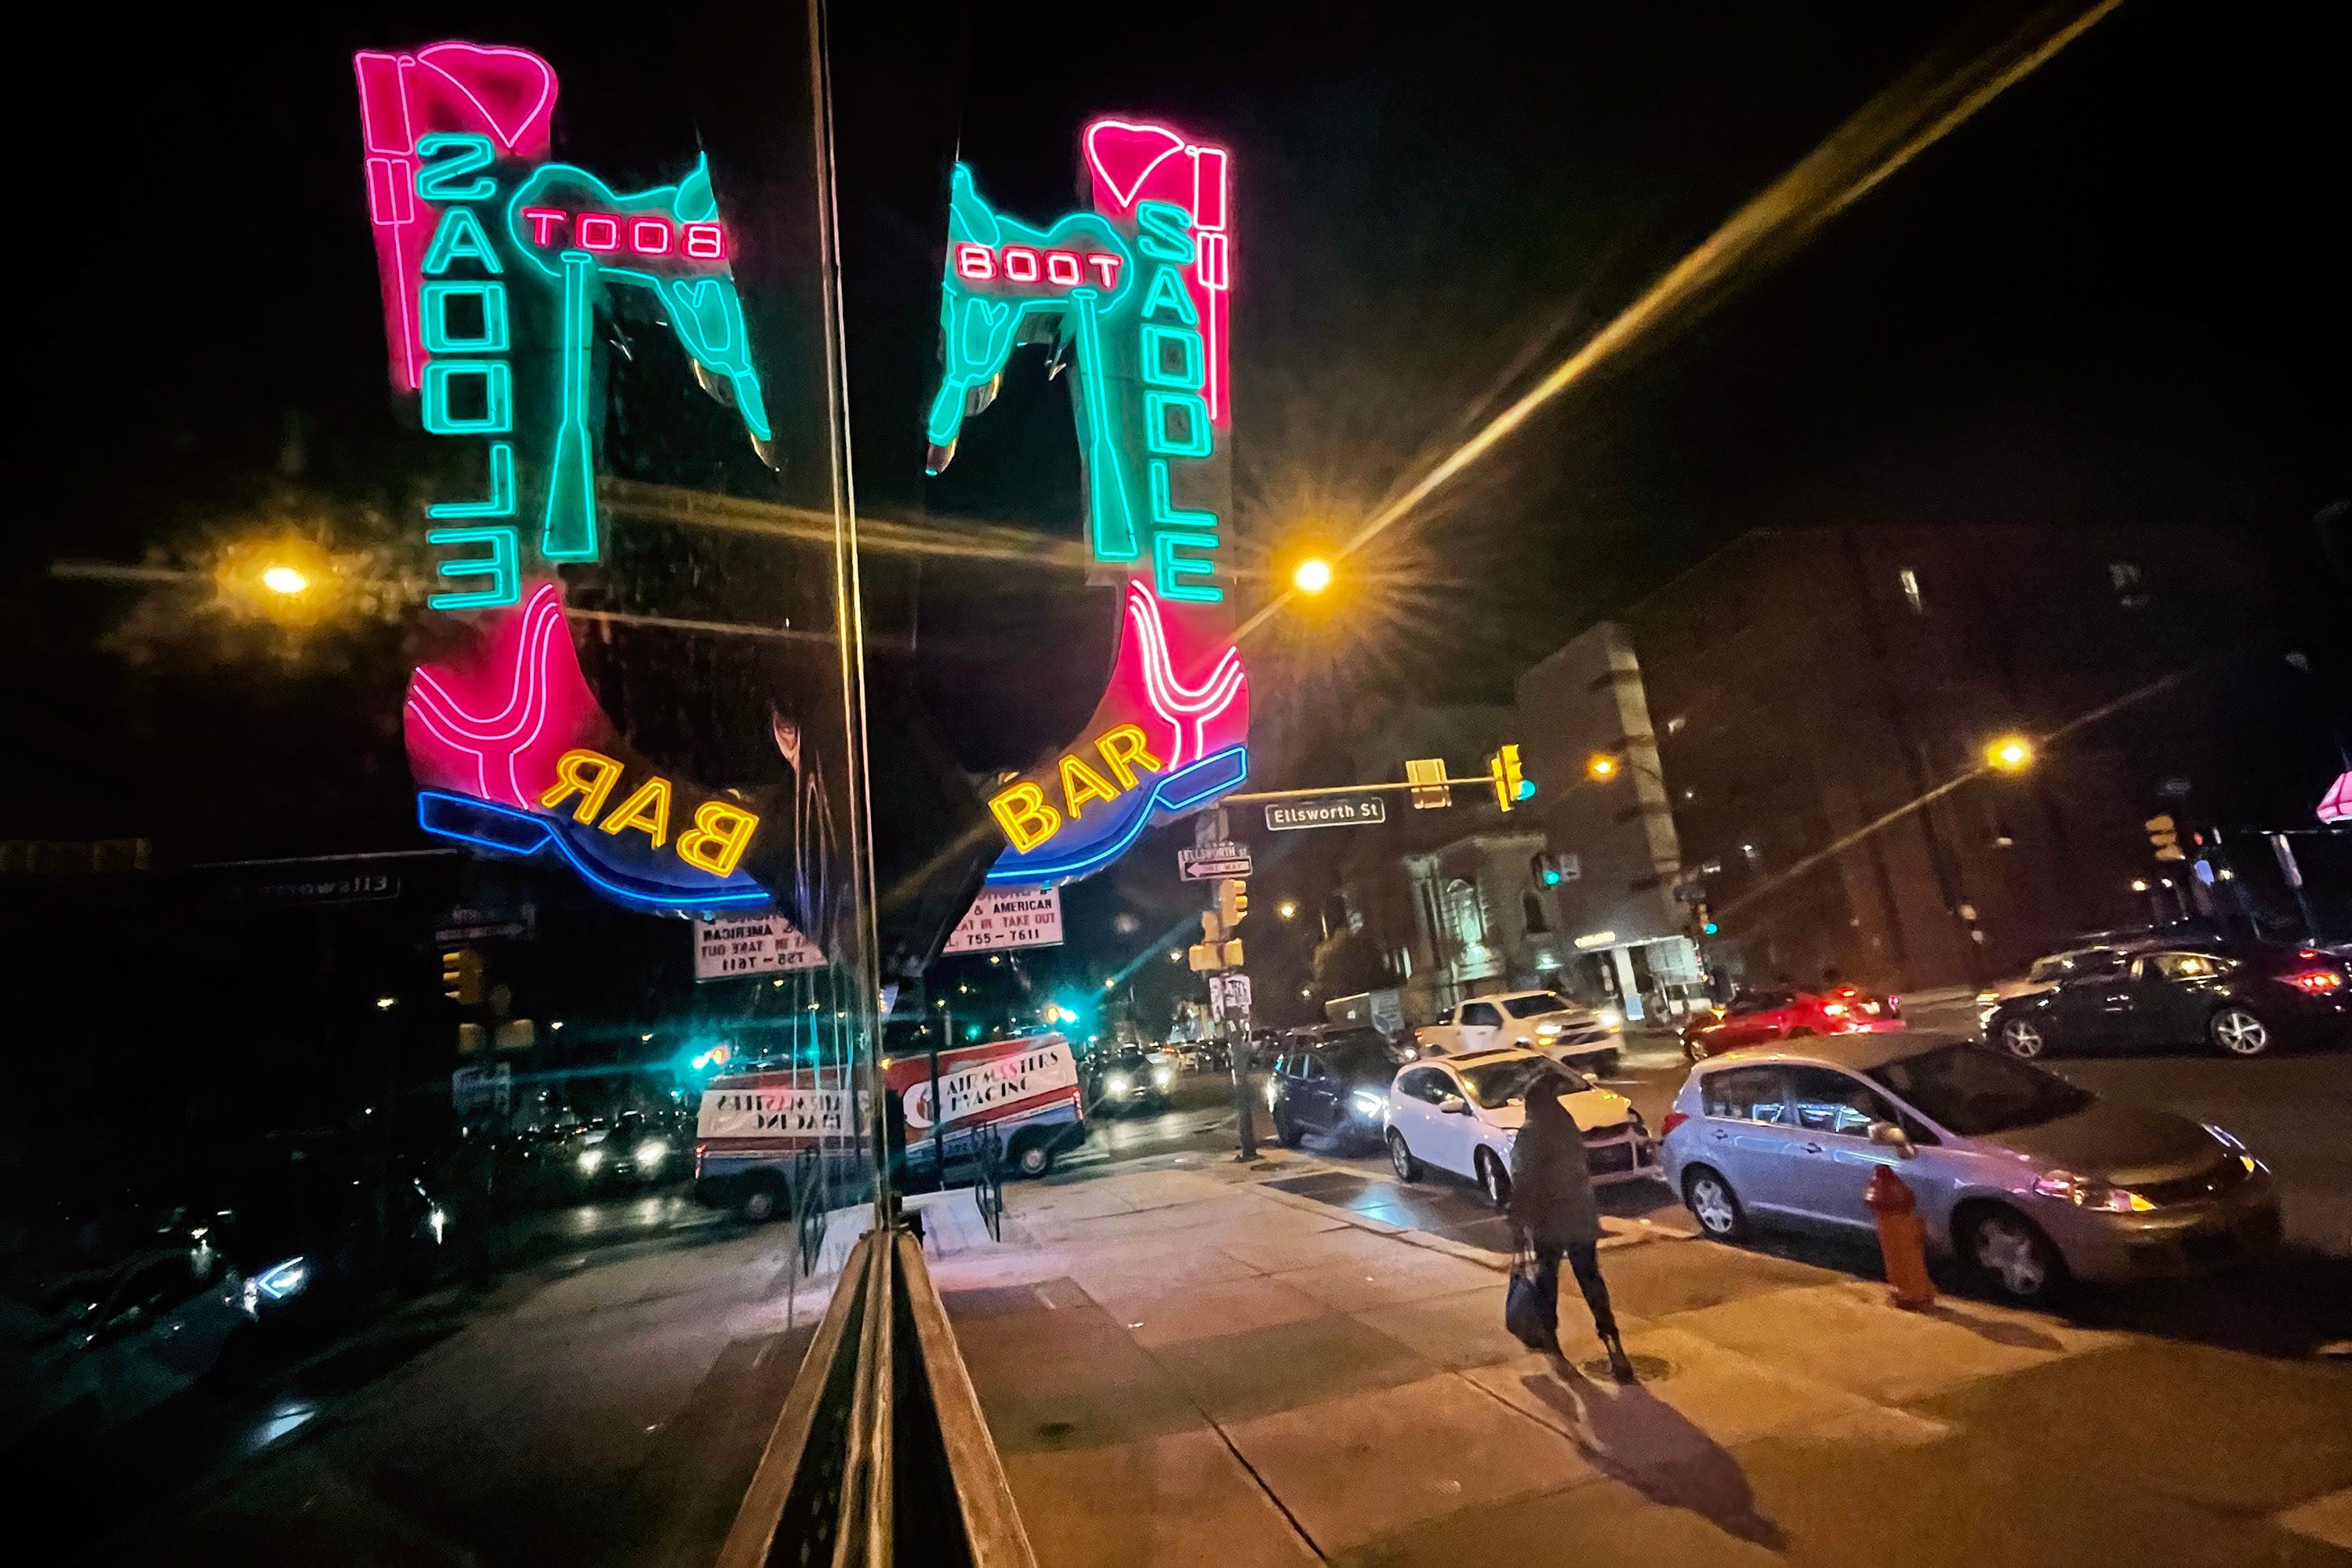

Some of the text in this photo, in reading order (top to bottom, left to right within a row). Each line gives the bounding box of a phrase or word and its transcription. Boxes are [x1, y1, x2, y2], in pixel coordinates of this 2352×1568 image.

[955, 242, 1123, 289] BOOT
[1136, 200, 1223, 603] SADDLE
[988, 724, 1163, 854] BAR
[1274, 803, 1378, 823] Ellsworth St
[993, 898, 1052, 914] AMERICAN
[1003, 915, 1030, 928] TAKE
[1035, 913, 1055, 925] OUT
[967, 933, 992, 946] 755
[1010, 928, 1040, 942] 7611
